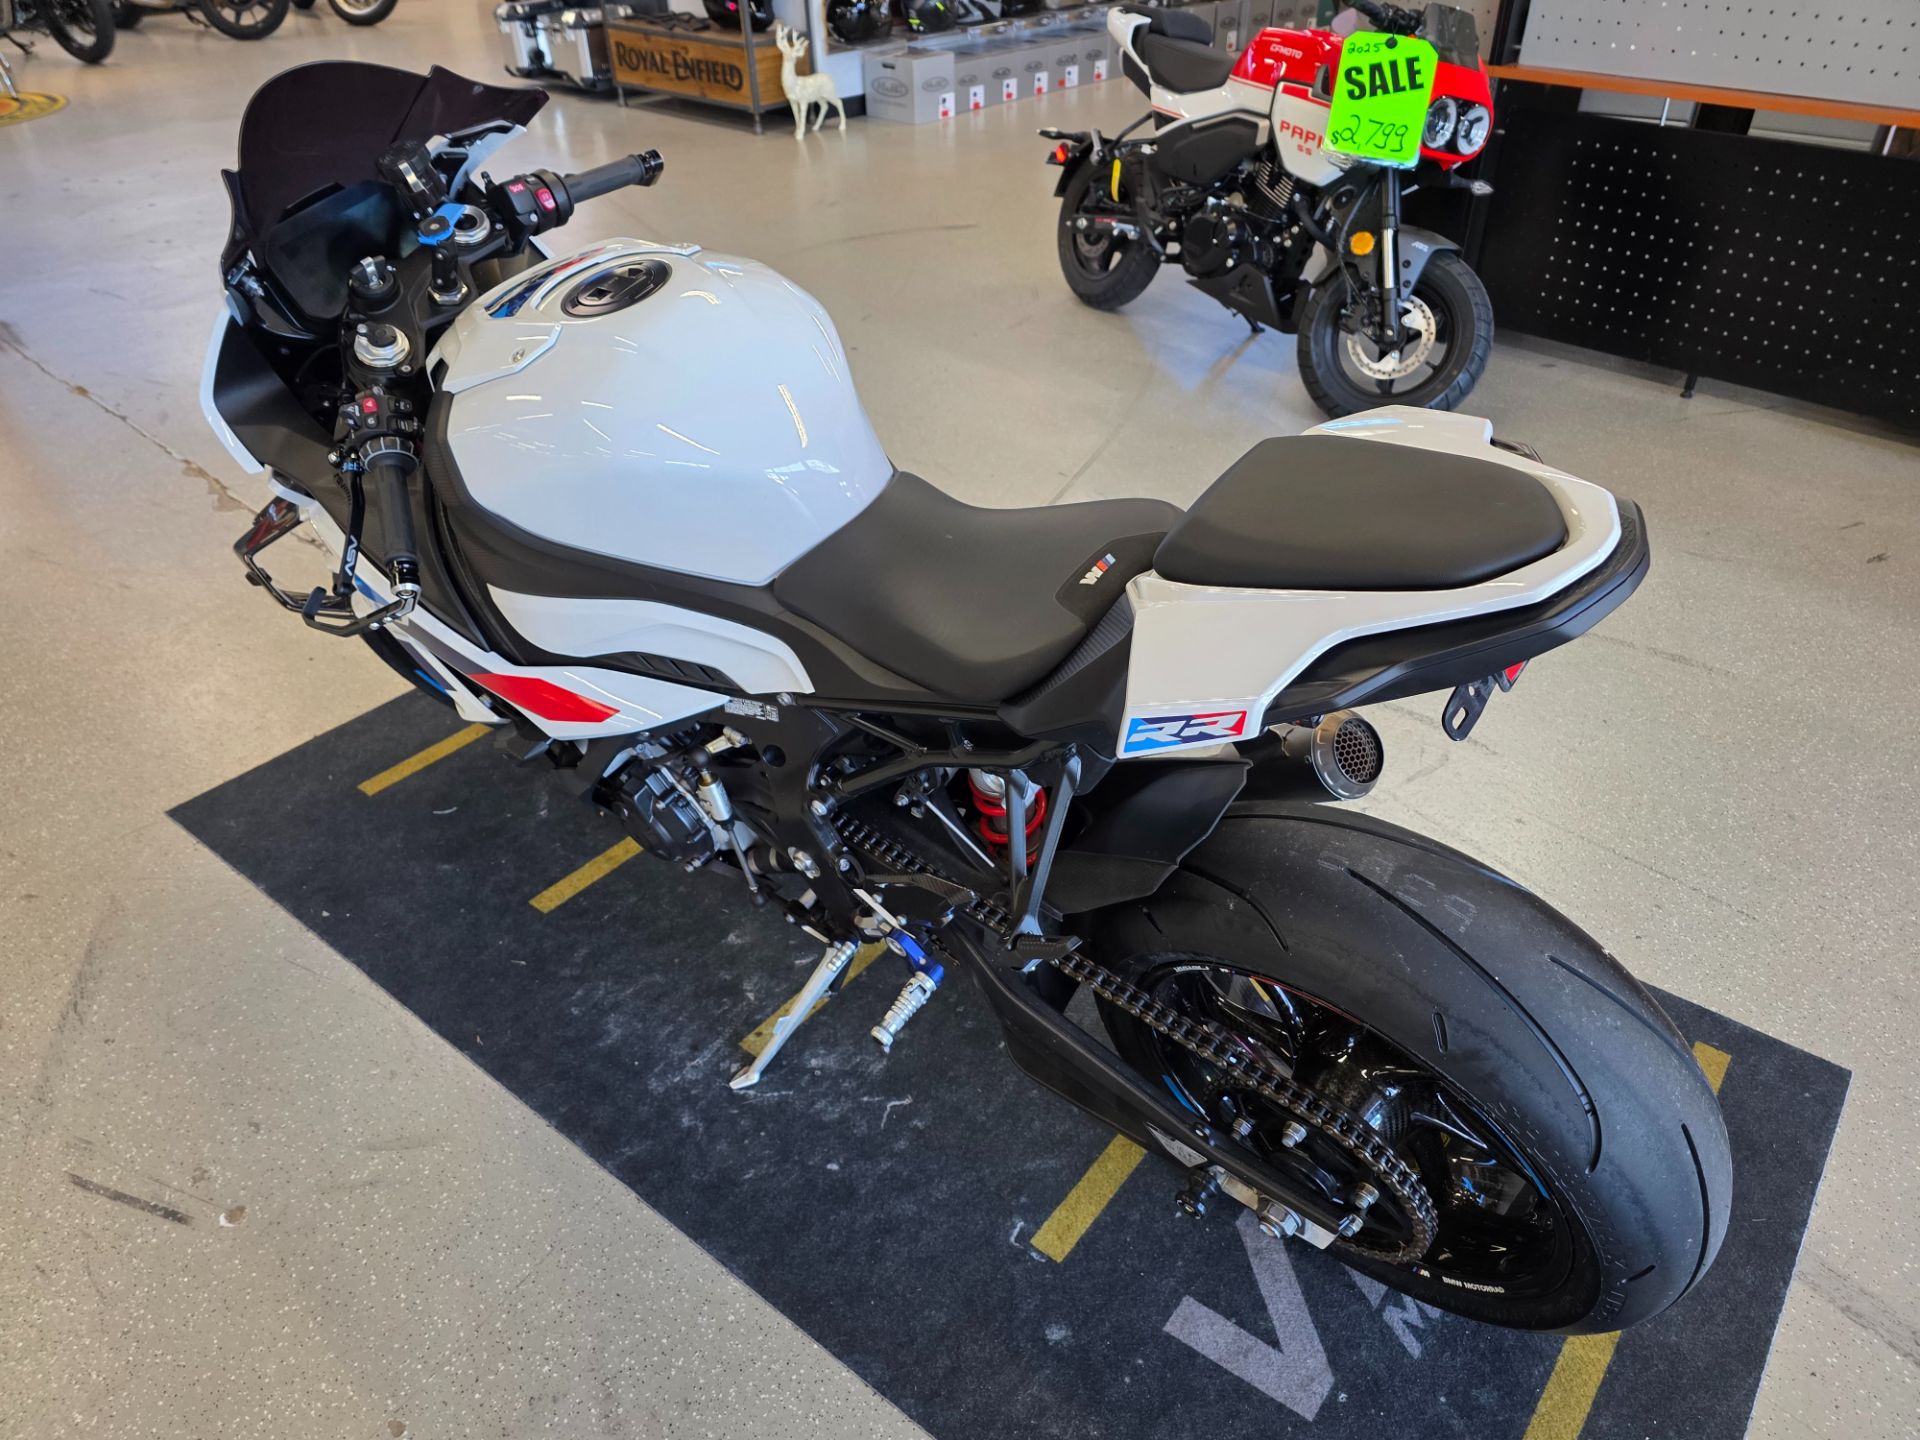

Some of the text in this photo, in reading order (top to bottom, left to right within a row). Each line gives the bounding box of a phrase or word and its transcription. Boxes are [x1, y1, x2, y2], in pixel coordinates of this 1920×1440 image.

[1269, 43, 1304, 60] CFMOTO
[1347, 42, 1386, 54] 2025
[615, 41, 669, 74] ROYAL
[671, 49, 743, 91] ENFIELD
[1344, 56, 1425, 101] SALE
[1280, 120, 1324, 149] PAPI
[345, 535, 358, 577] ASV
[1126, 712, 1245, 746] RR
[1442, 1276, 1505, 1293] BMW MOTORRAD
